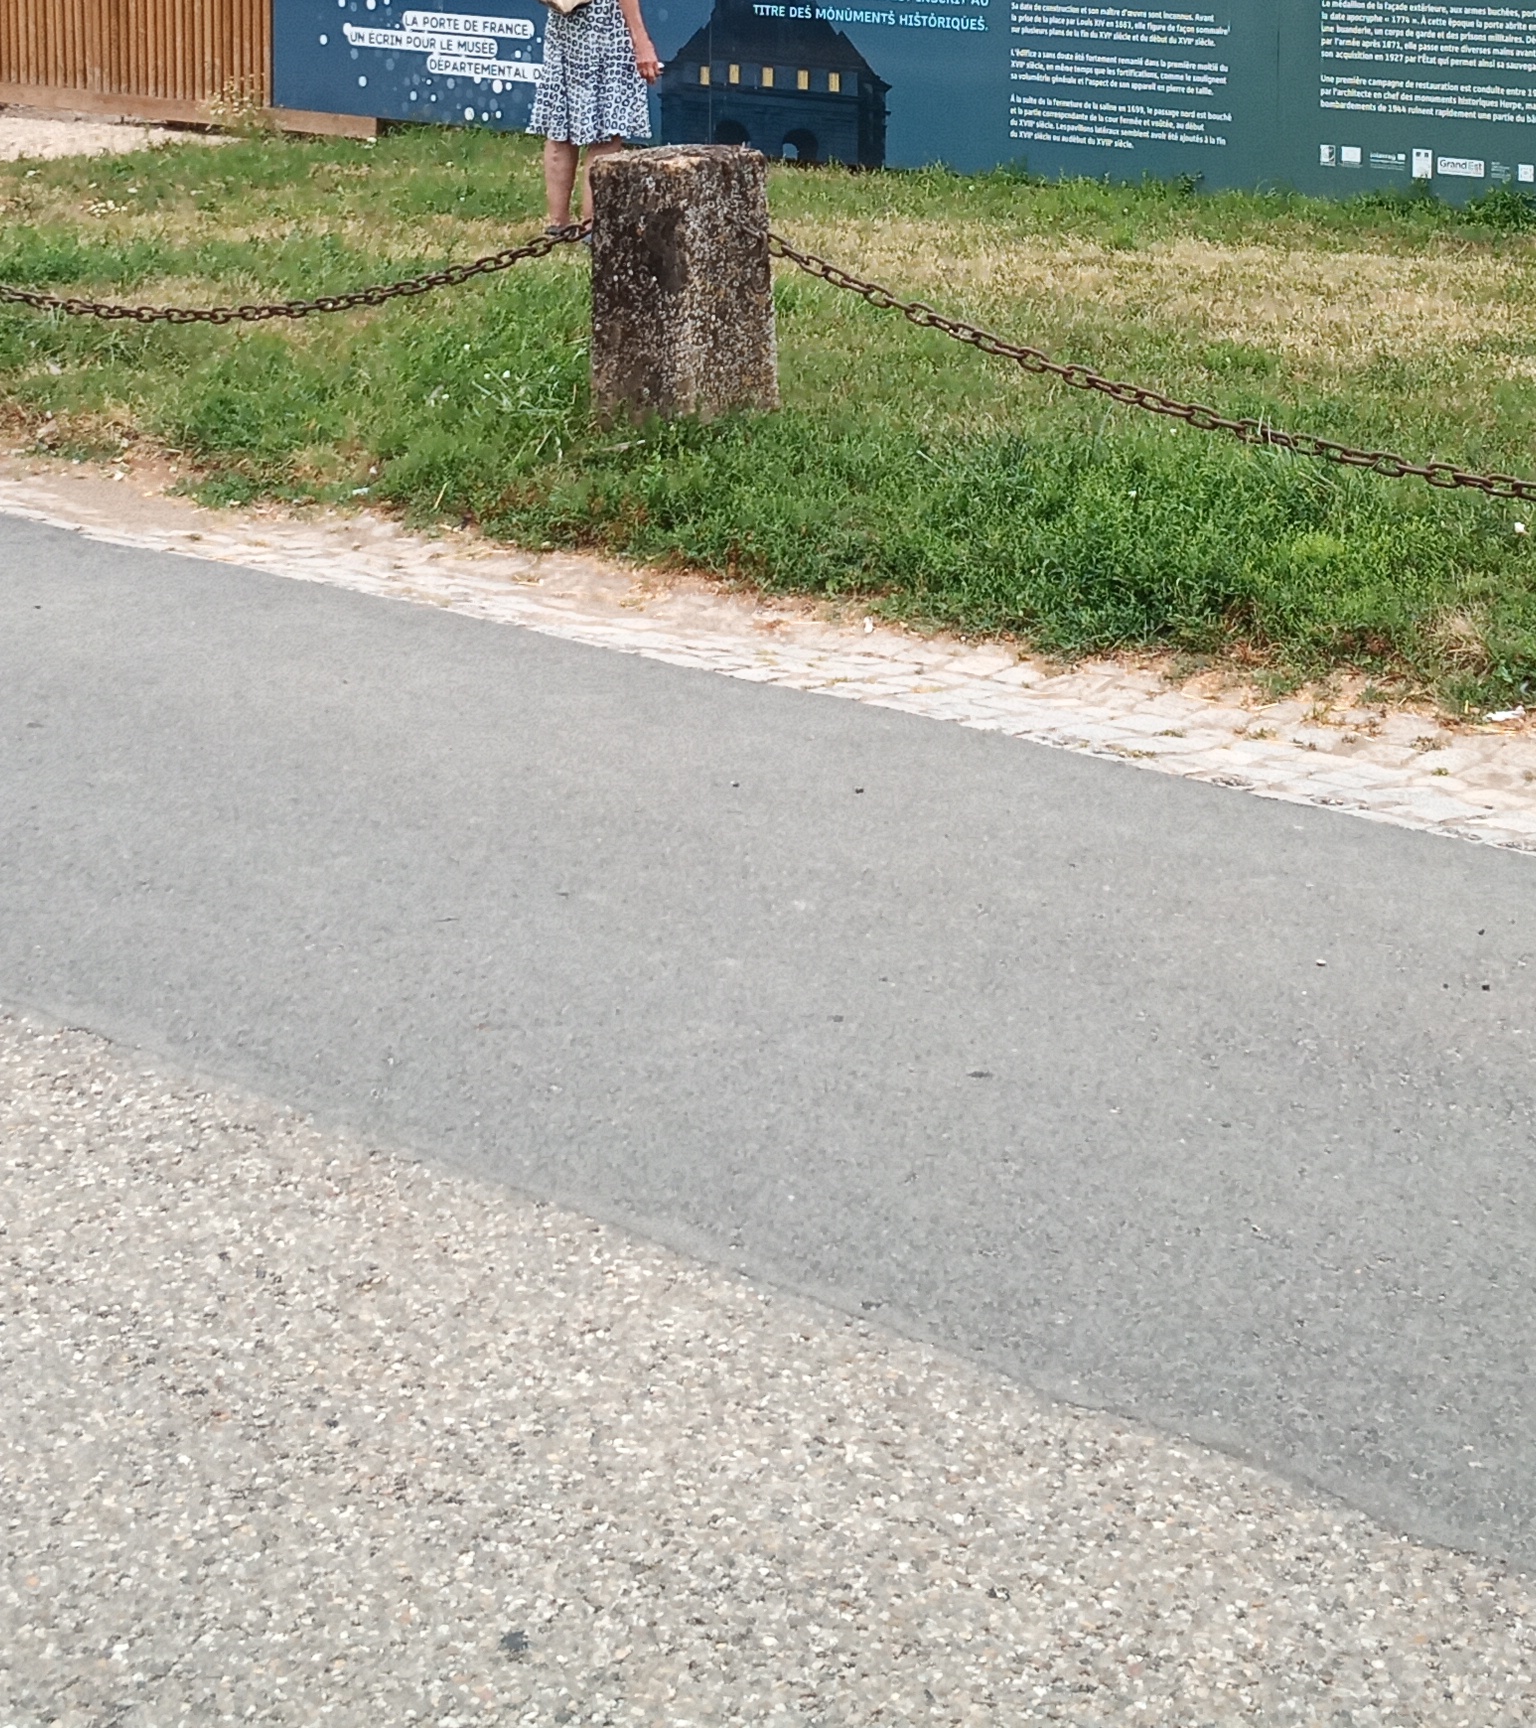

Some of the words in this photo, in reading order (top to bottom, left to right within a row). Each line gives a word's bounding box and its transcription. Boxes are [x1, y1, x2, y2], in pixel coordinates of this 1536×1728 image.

[752, 4, 786, 17] TITRE
[404, 15, 418, 27] LA
[422, 16, 460, 31] PORTE
[464, 19, 478, 33] DE
[350, 32, 365, 44] UN
[368, 31, 403, 46] ÉCRIN
[406, 36, 436, 50] POUR
[440, 39, 453, 52] LE
[457, 40, 496, 56] MUSÉE
[429, 58, 529, 80] DÉPARTEMENTAL
[1440, 159, 1467, 170] Grand
